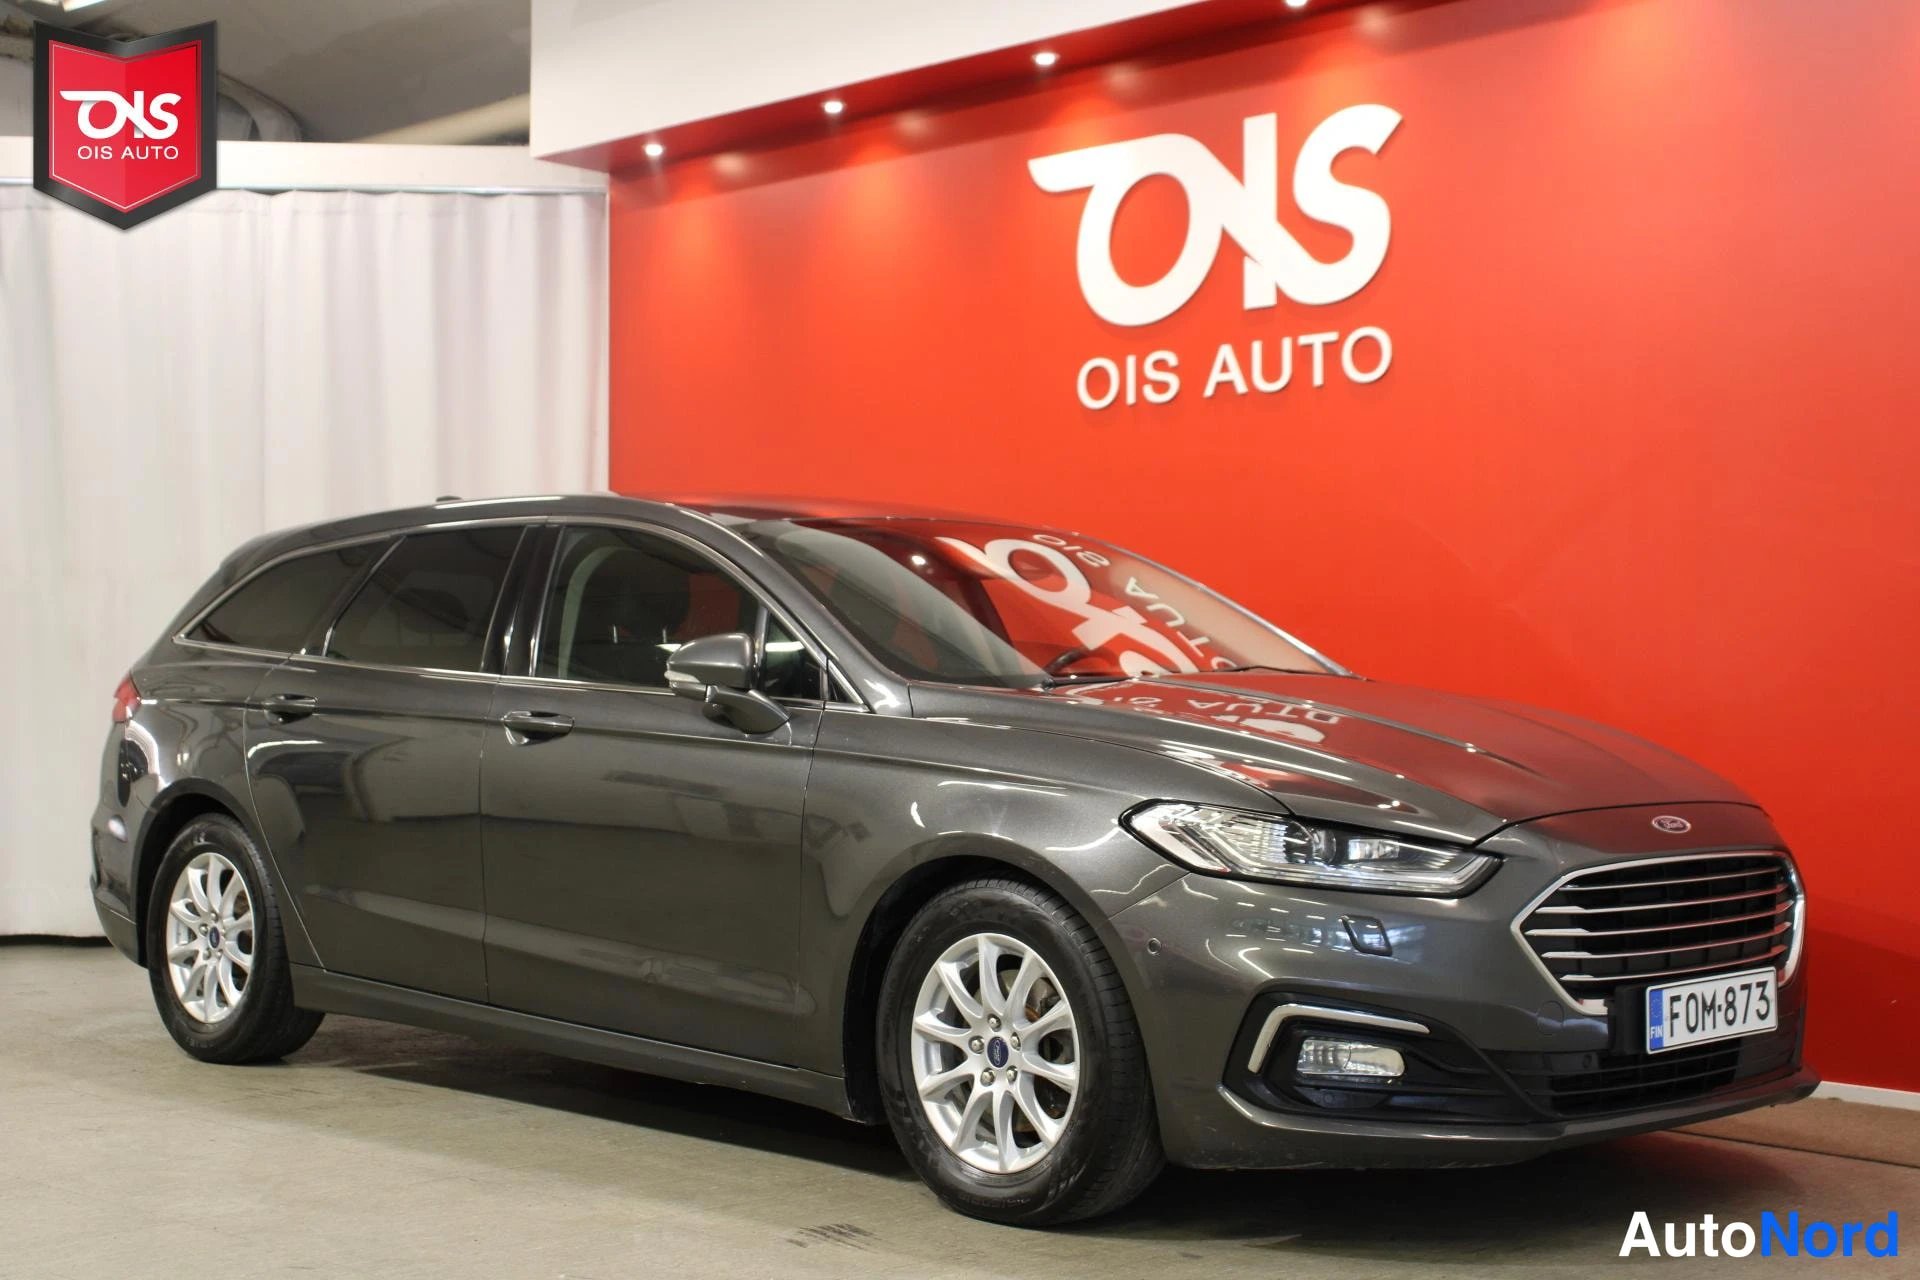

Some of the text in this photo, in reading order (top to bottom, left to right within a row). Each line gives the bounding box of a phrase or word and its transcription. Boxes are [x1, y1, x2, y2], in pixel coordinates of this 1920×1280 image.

[1076, 326, 1393, 410] OIS AUTO
[1650, 1025, 1664, 1039] FIN
[1668, 979, 1771, 1038] FOM-873
